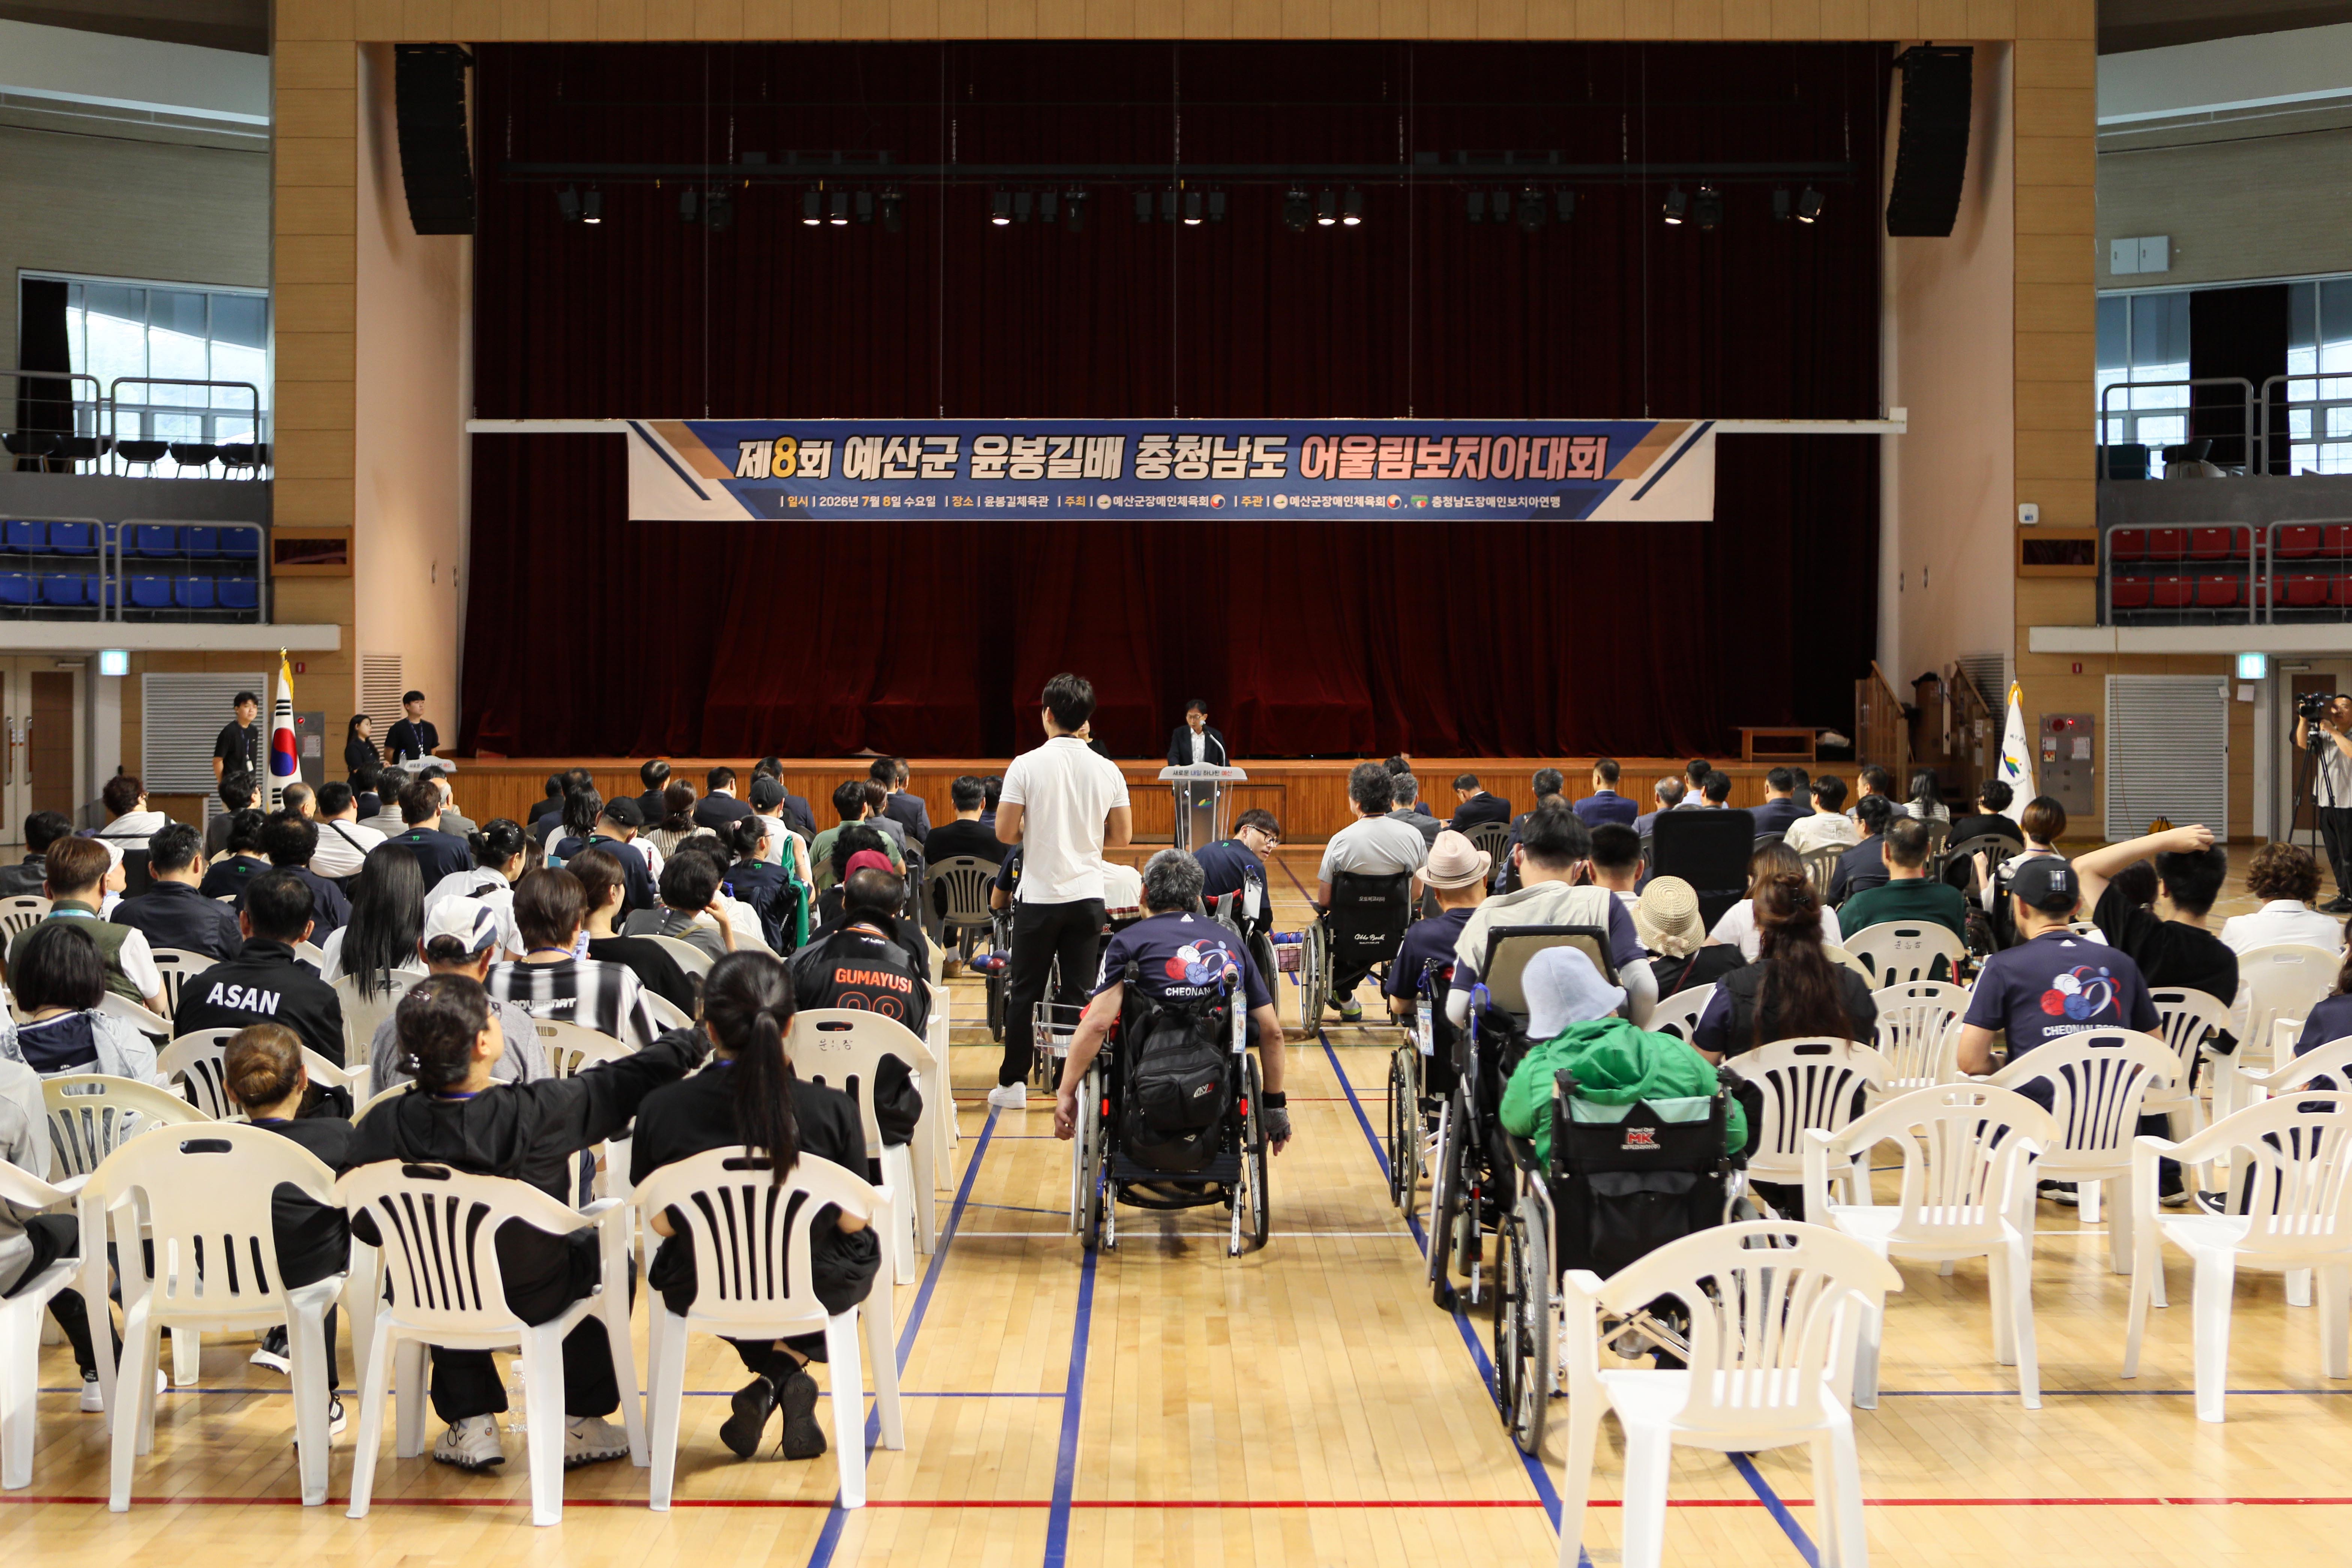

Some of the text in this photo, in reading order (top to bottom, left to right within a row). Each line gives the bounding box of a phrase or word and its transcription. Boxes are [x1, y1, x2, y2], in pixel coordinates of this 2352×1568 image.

[734, 434, 1609, 481] 제8회 예산군 윤봉길배 충청남도 어울림보치아대회
[788, 496, 936, 508] 일시 2026년 7월 8일 수요일
[952, 496, 1049, 508] 장소 윤봉길체육관
[1065, 496, 1209, 508] 주최 예산군장애인체육회
[1241, 496, 1560, 508] 주관 예산군장애인체육회 충청남도장애인보치아연맹
[835, 968, 913, 993] GUMAYUSI
[1165, 987, 1211, 996] CHEONAN
[206, 982, 281, 1015] ASAN
[819, 1039, 853, 1051] 운장
[1628, 1132, 1655, 1144] MK
